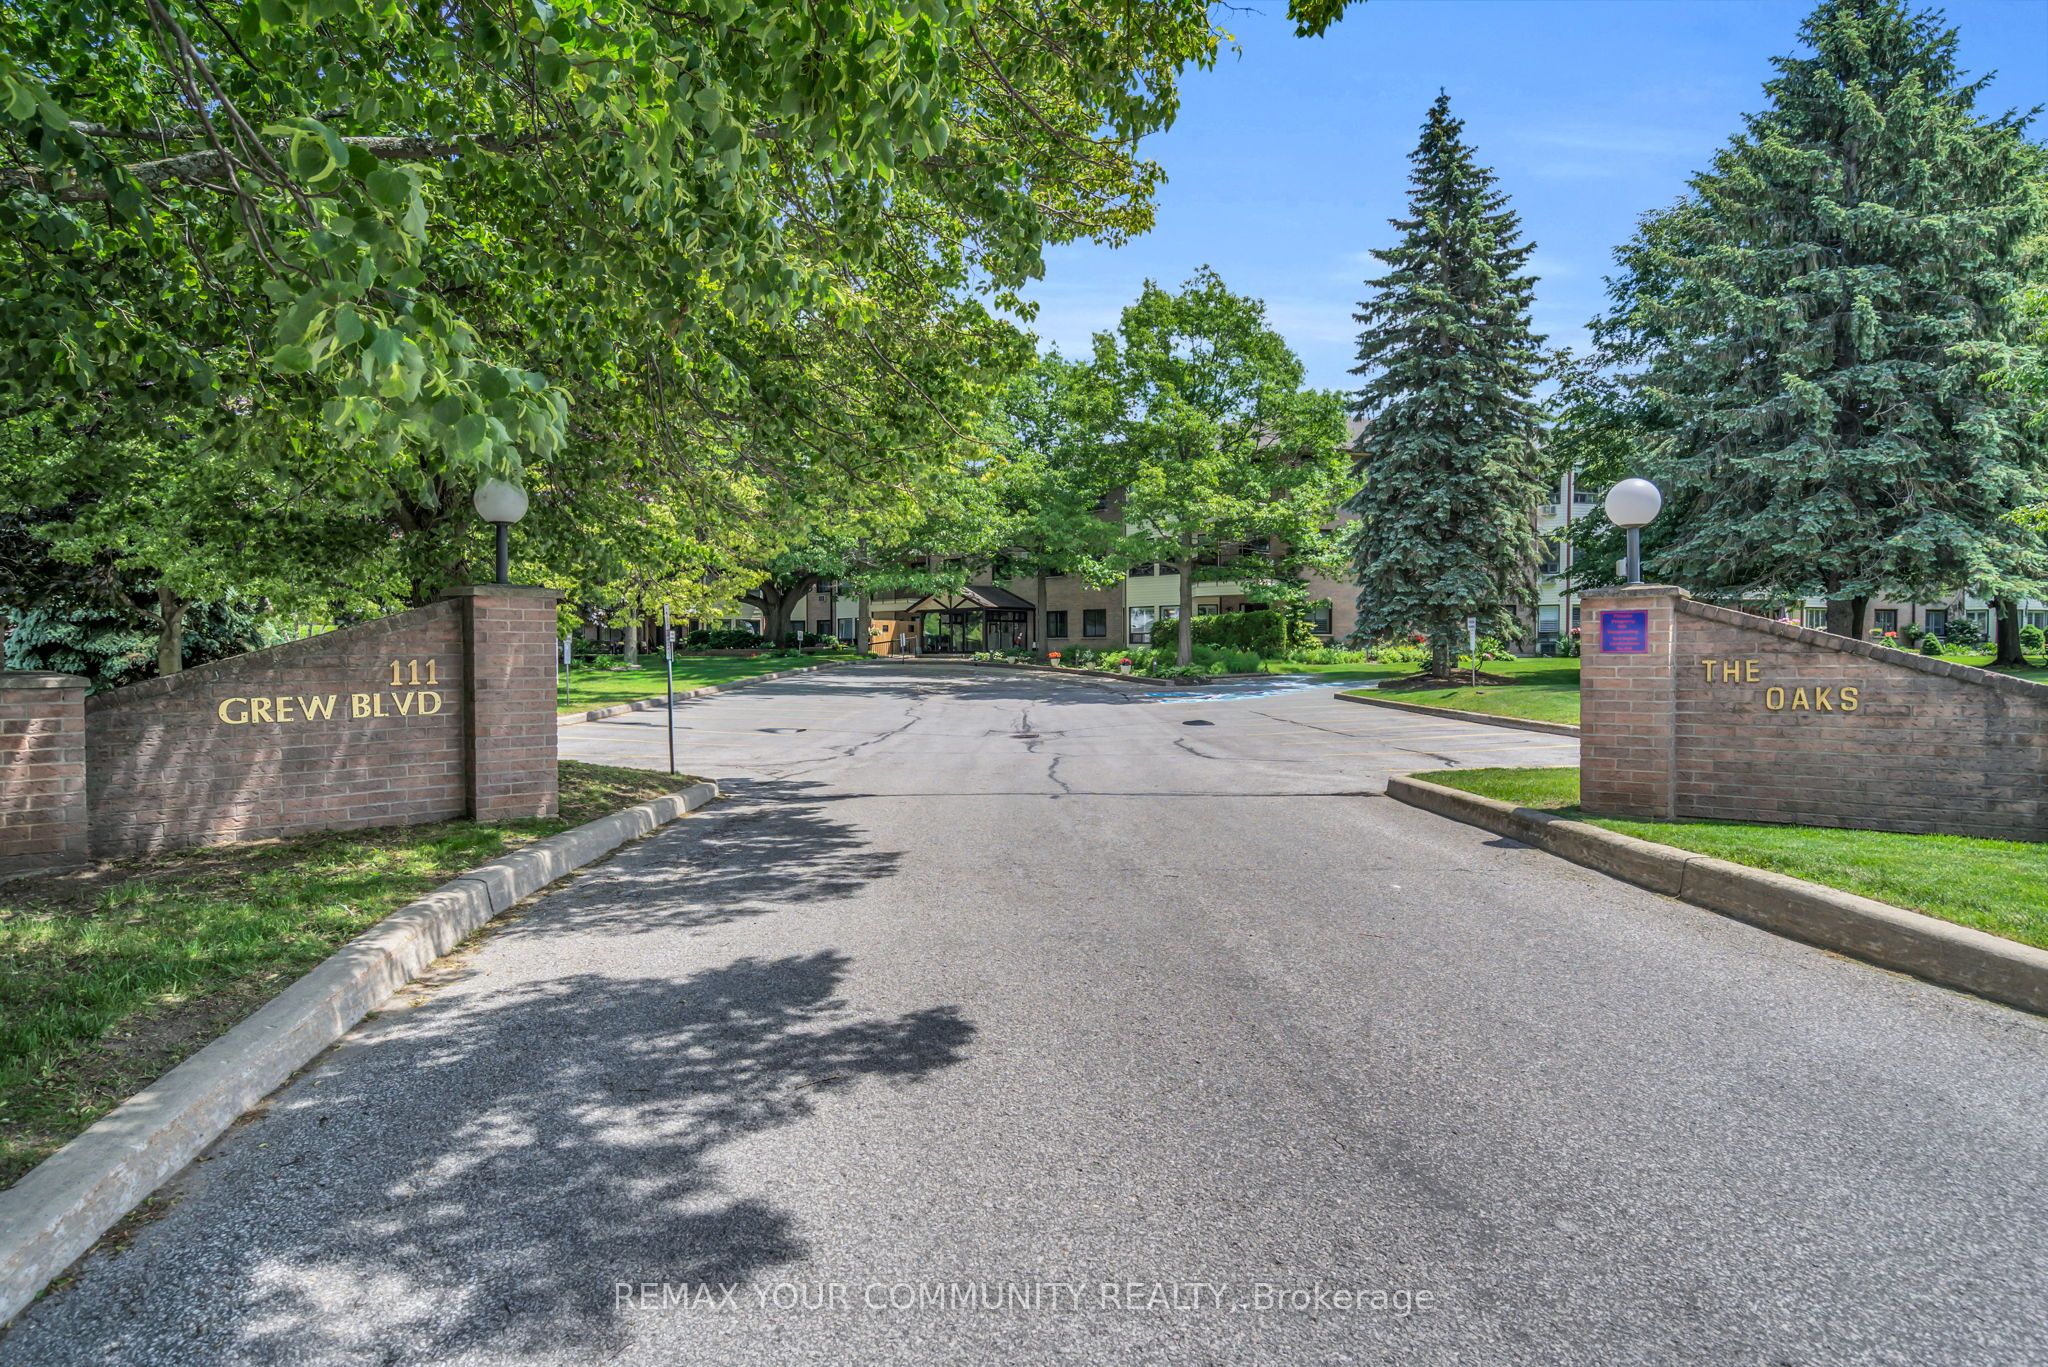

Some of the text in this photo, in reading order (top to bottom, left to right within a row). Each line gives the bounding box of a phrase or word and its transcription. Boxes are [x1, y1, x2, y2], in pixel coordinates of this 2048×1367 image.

[390, 659, 439, 686] 111
[1701, 659, 1760, 683] THE
[218, 691, 442, 724] GREW BLVD
[1766, 686, 1858, 711] OAKS
